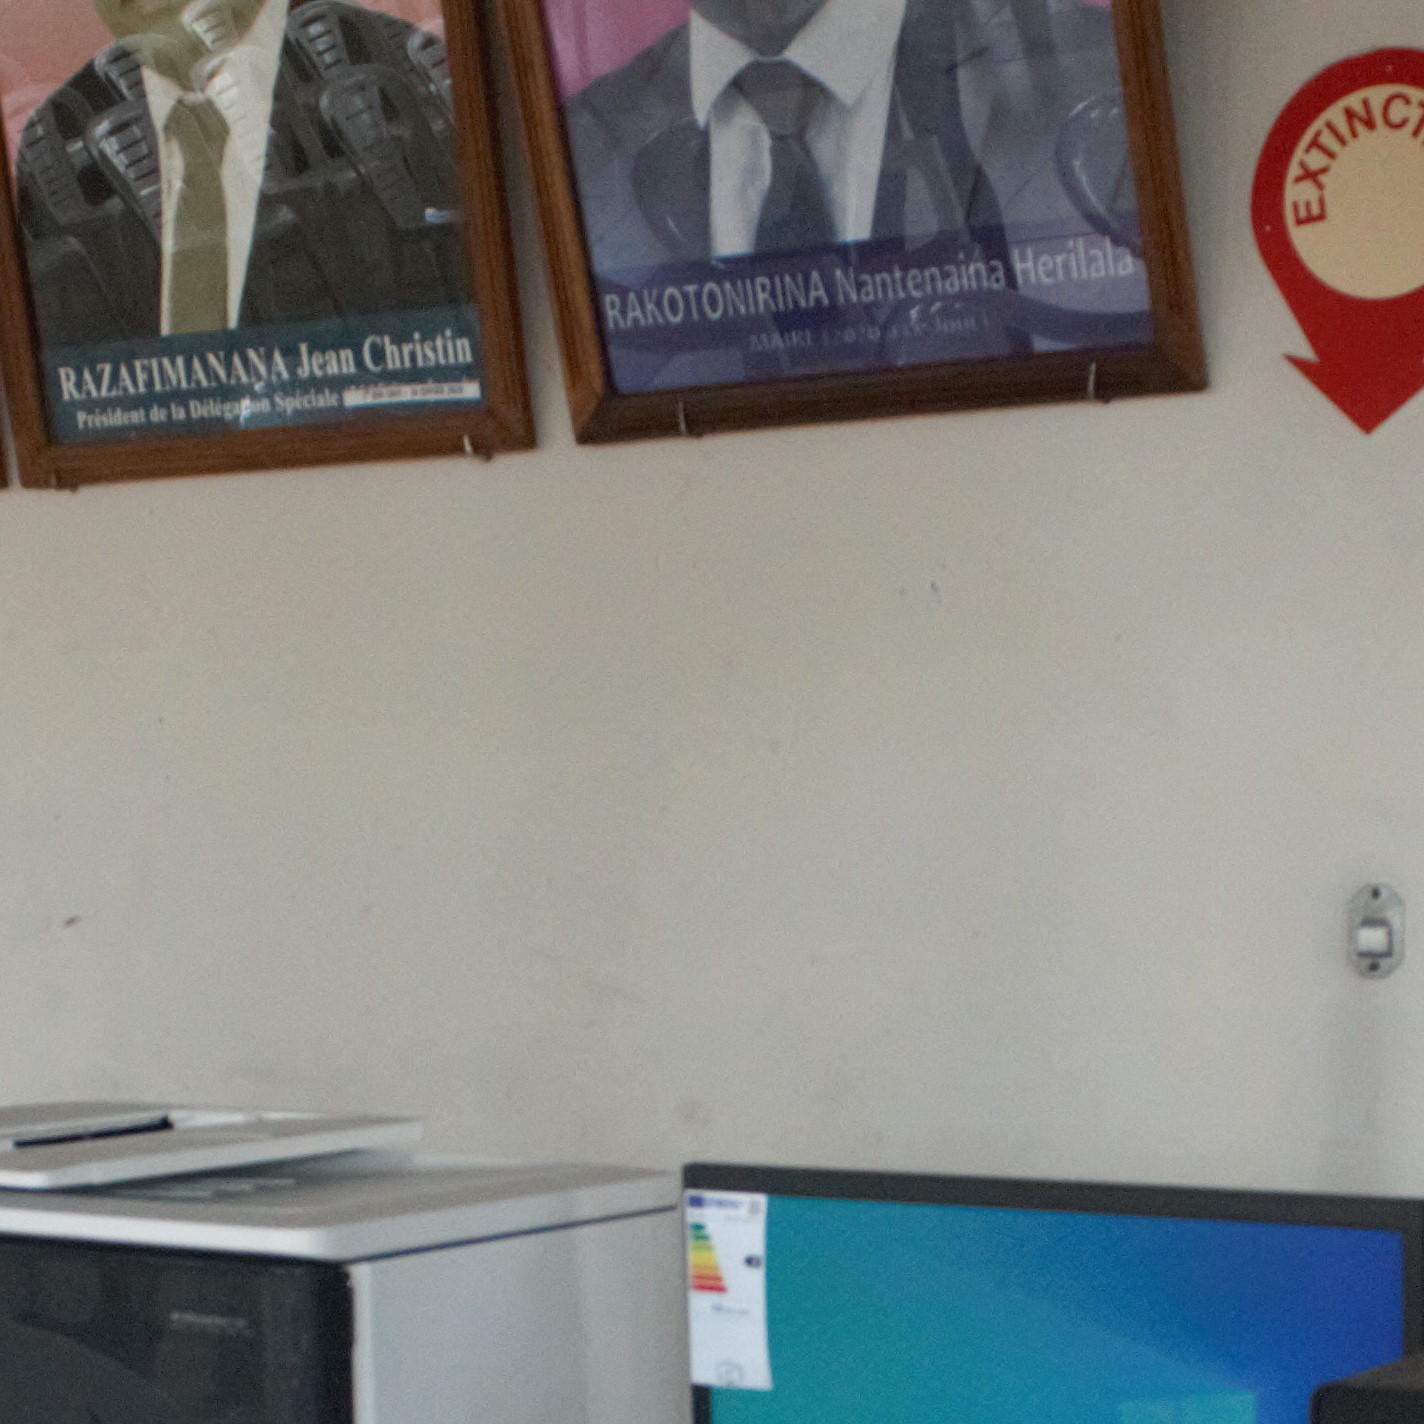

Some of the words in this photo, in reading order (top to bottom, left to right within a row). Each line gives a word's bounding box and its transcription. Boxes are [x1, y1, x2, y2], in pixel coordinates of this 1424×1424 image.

[603, 268, 827, 330] RAKOTONIRINA
[835, 253, 1006, 303] Nantenaina
[1013, 235, 1135, 288] Herilala
[58, 346, 289, 401] RAZAFIMANANA
[296, 341, 356, 379] Jean
[362, 327, 474, 373] Christin
[77, 405, 145, 429] Président
[149, 404, 167, 423] de
[170, 402, 186, 421] la
[189, 396, 270, 422] Délégaon
